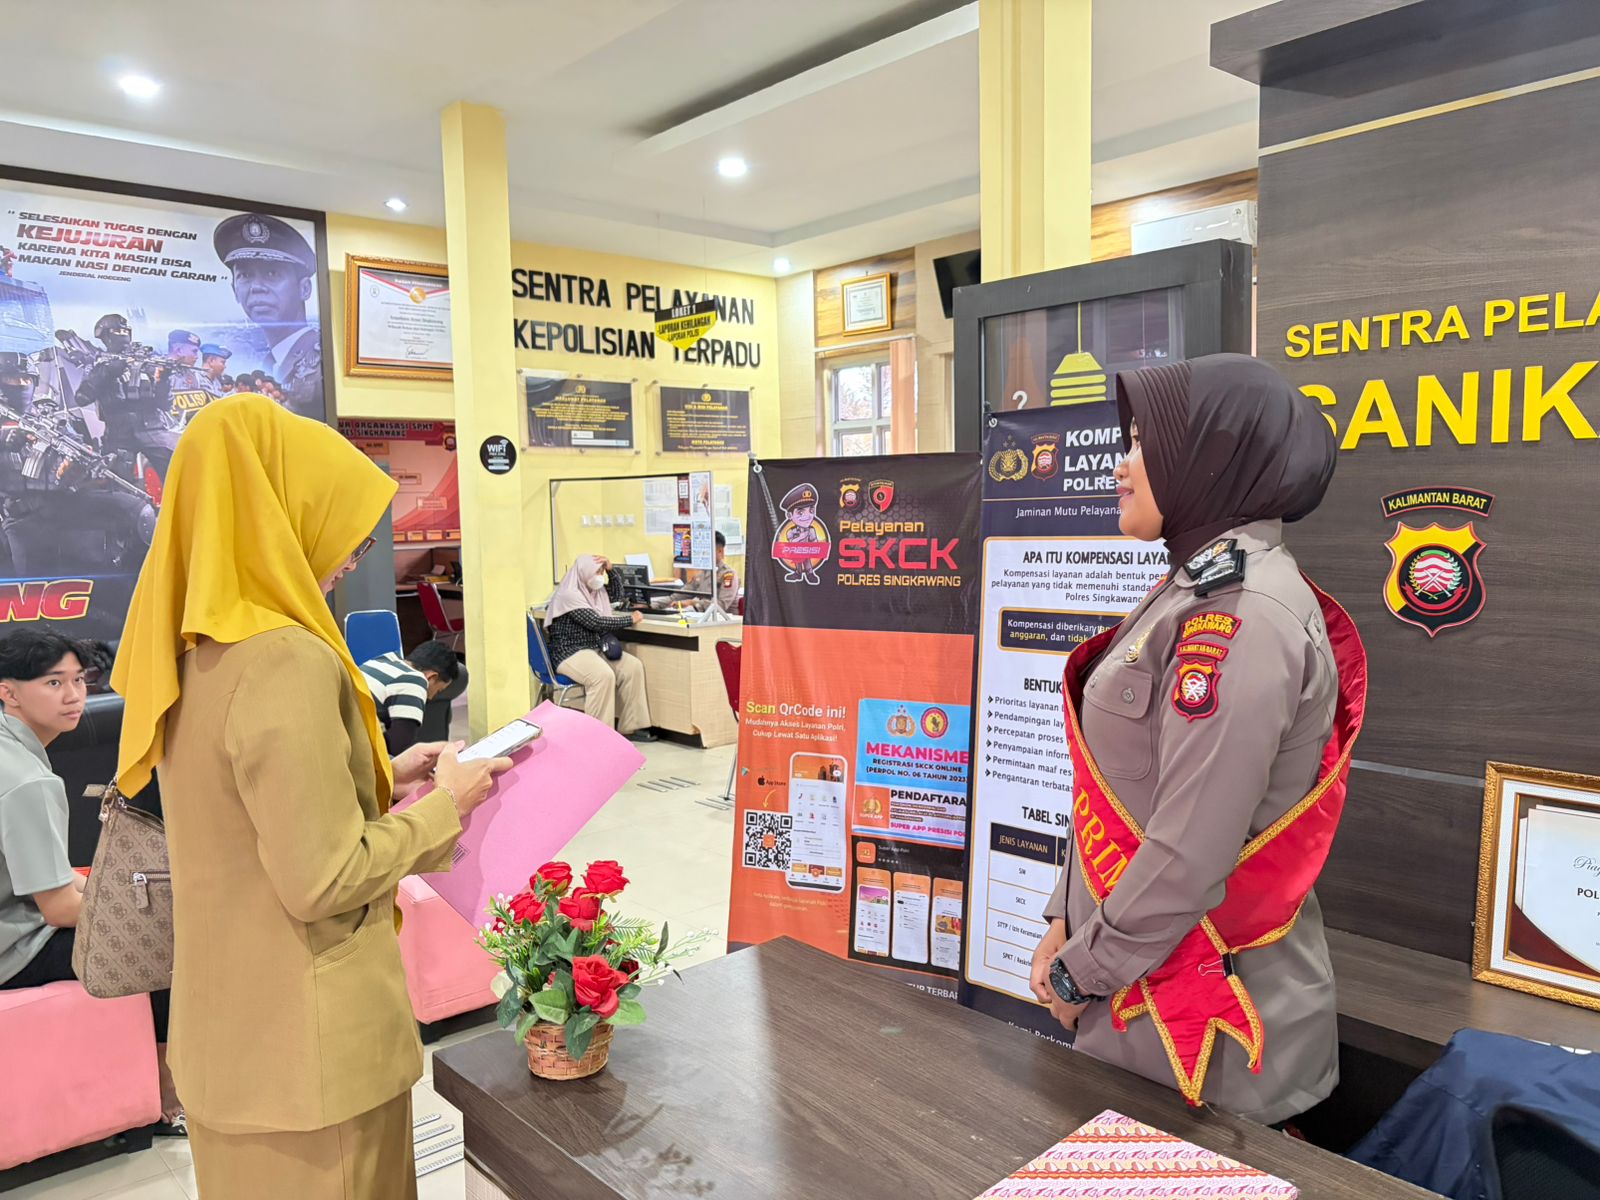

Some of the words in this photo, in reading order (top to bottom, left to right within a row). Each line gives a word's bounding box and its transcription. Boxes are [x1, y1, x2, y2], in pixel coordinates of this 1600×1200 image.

[18, 211, 100, 229] SELESAIKAN
[104, 221, 144, 234] TUGAS
[147, 227, 198, 241] DENGAN
[17, 223, 164, 253] KEJUJURAN
[18, 242, 77, 256] KARENA
[80, 248, 111, 259] KITA
[114, 253, 158, 264] MASIH
[161, 257, 192, 268] BISA
[18, 254, 72, 267] MAKAN
[75, 260, 109, 271] NASI
[112, 264, 167, 277] DENGAN
[170, 270, 218, 283] GARAM
[59, 270, 96, 279] JENDERAL
[512, 268, 611, 308] SENTRA
[626, 282, 755, 325] PELAYNAN
[671, 305, 691, 318] LOKET
[514, 318, 656, 359] KEPOLISIAN
[1285, 305, 1470, 358] SENTRA
[354, 421, 409, 429] ORGANISASI
[1065, 427, 1122, 448] KOMP
[1388, 492, 1450, 511] KALIMANTAN
[1452, 493, 1488, 510] BARAT
[1016, 507, 1051, 518] Jaminan
[1054, 506, 1078, 517] Mutu
[1080, 505, 1122, 517] Pelayana
[839, 520, 925, 536] Pelayanan
[838, 538, 960, 570] SKCK
[1022, 551, 1043, 564] APA
[1045, 551, 1063, 564] ITU
[1065, 551, 1134, 565] KOMPENSASI
[1137, 551, 1170, 566] LAYA
[837, 573, 881, 586] POLRES
[883, 575, 961, 588] SINGKAWANG
[1004, 568, 1050, 579] Kompensasi
[1052, 570, 1083, 580] layanan
[1085, 570, 1113, 580] adalah
[1115, 571, 1146, 580] bentuk
[991, 579, 1030, 589] pelayanan
[1031, 581, 1051, 590] yang
[1053, 581, 1073, 590] tidak
[1075, 582, 1119, 591] memenuhi
[1065, 593, 1090, 602] Polres
[1007, 619, 1054, 630] Kompensasi
[1056, 621, 1095, 632] diberikan
[1184, 613, 1233, 627] POLRES
[1009, 631, 1048, 641] anggaran,
[1050, 632, 1066, 642] dan
[1067, 633, 1088, 643] tidak
[1023, 677, 1063, 694] BENTUK
[746, 701, 776, 714] Scan
[779, 703, 823, 717] QrCode
[826, 705, 847, 719] ini!
[994, 696, 1027, 708] Prioritas
[1029, 699, 1059, 712] layanan
[780, 720, 800, 728] Akses
[801, 721, 826, 730] Layanan
[994, 711, 1051, 727] Pendampingan
[1053, 718, 1065, 729] lay
[794, 732, 810, 740] Satu
[993, 725, 1035, 740] Percepatan
[1037, 732, 1064, 744] proses
[866, 742, 969, 765] MEKANISME
[993, 740, 1043, 756] Penyampaian
[866, 766, 896, 776] (PERPOL
[897, 769, 911, 777] NO.
[923, 773, 947, 781] TAHUN
[873, 758, 914, 768] REGISTRASI
[915, 762, 934, 770] SKCK
[935, 764, 963, 773] ONLINE
[992, 755, 1035, 770] Permintaan
[1037, 764, 1058, 774] maaf
[1059, 767, 1072, 777] res
[992, 770, 1040, 786] Pengantaran
[891, 789, 967, 807] PENDAFTARA
[1021, 805, 1052, 825] TABEL
[1055, 812, 1070, 828] SIN
[891, 822, 911, 830] SUPER
[912, 824, 927, 832] APP
[998, 834, 1016, 846] JENIS
[1016, 838, 1048, 854] LAYANAN
[1577, 887, 1600, 900] POL
[997, 921, 1009, 929] STTP
[1002, 952, 1013, 962] SPKT
